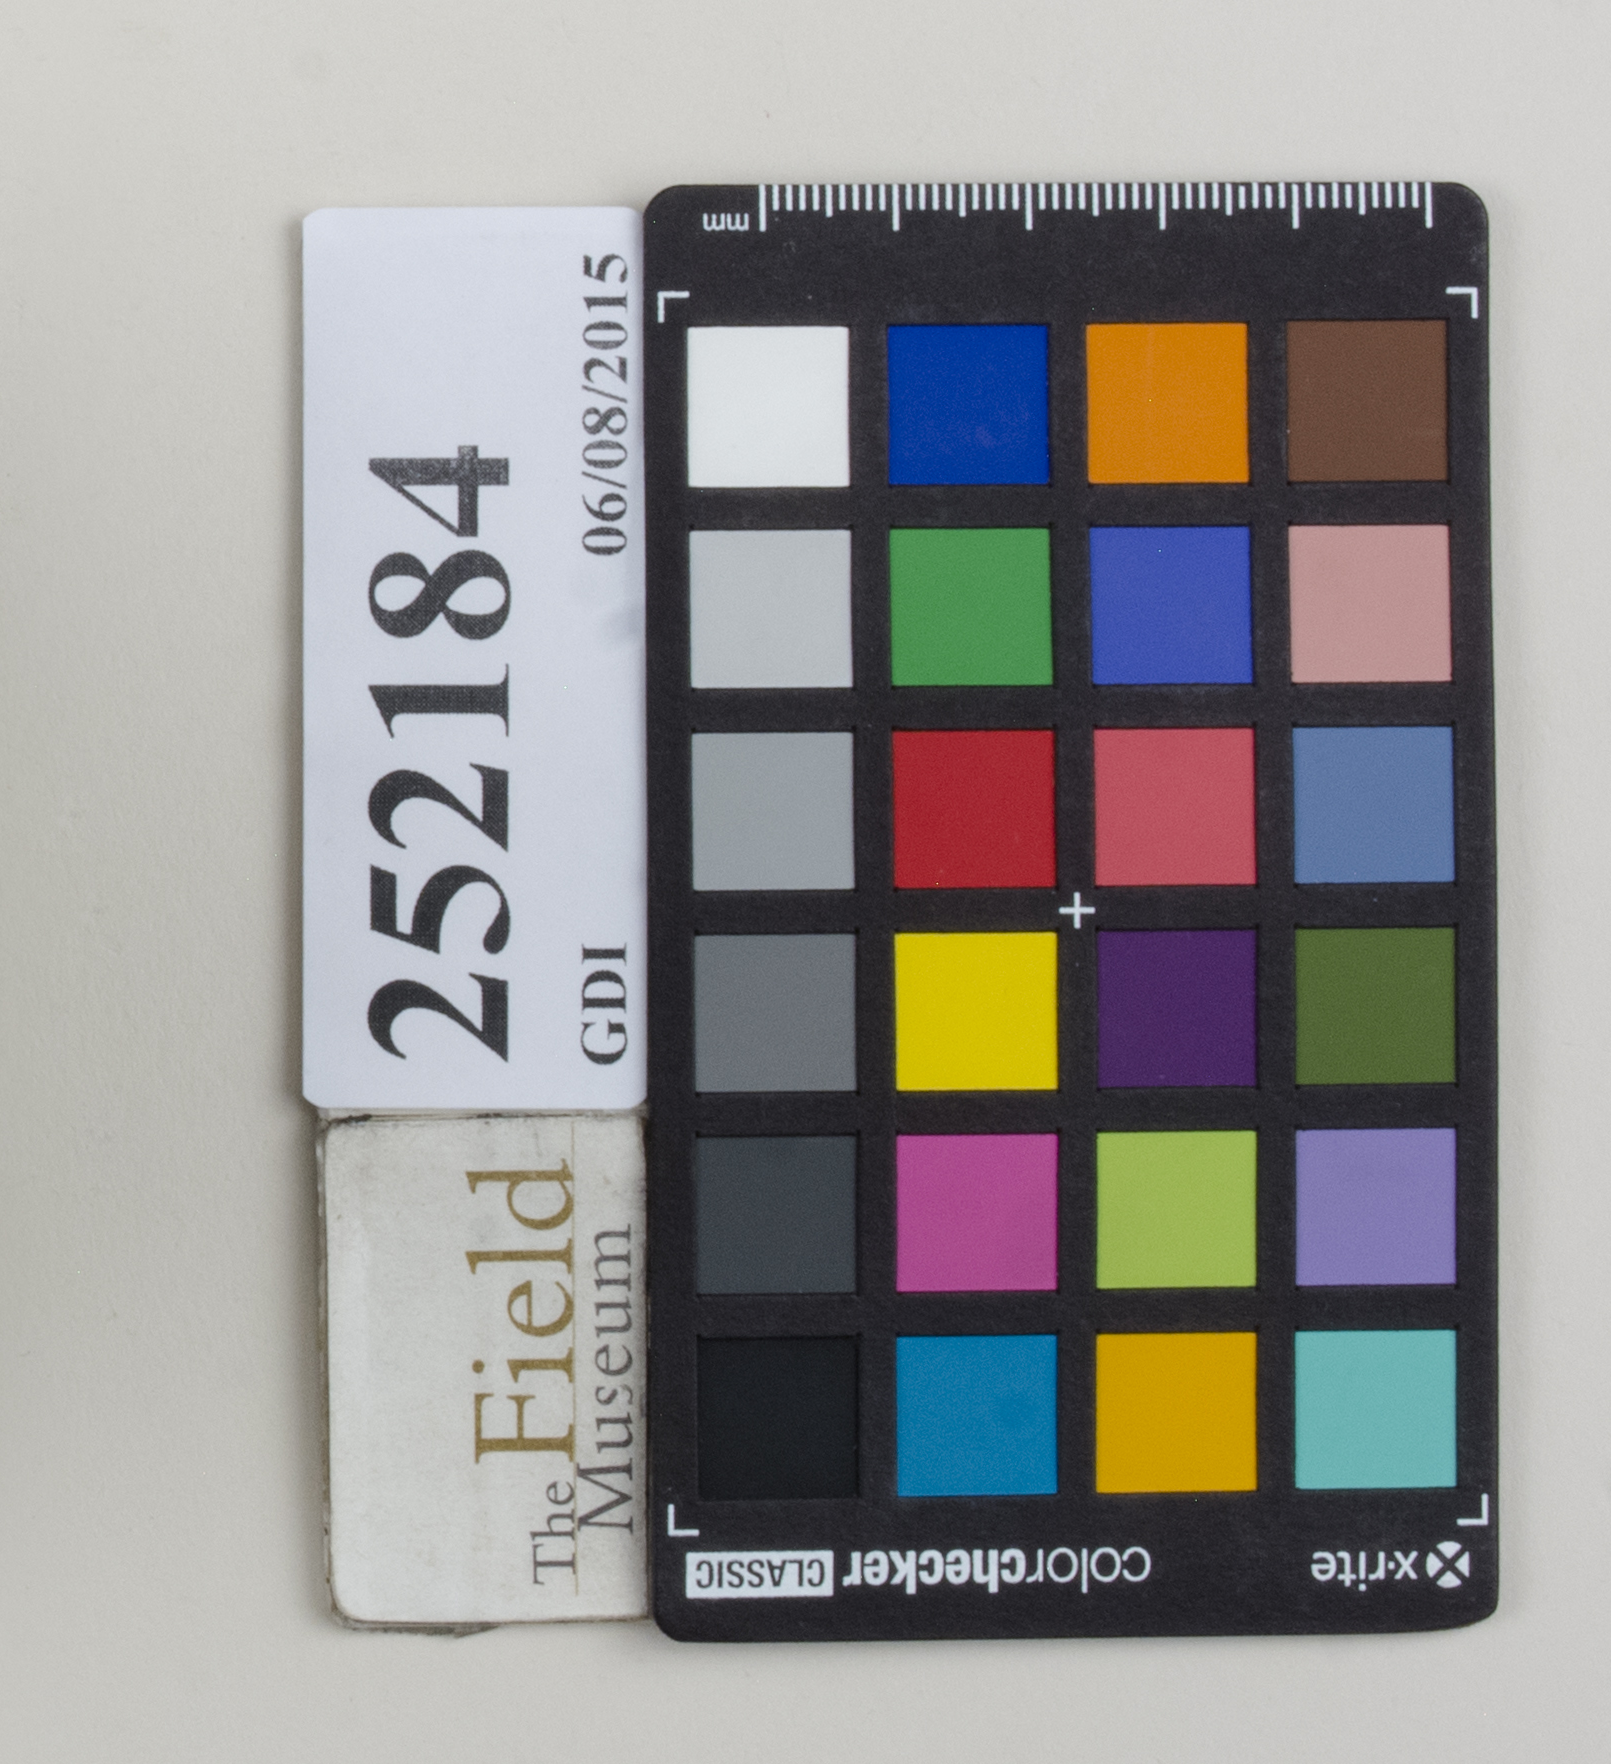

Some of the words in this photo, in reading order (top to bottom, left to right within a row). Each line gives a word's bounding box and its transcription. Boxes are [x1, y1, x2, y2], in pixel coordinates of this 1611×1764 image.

[702, 212, 750, 231] mm
[582, 253, 629, 556] 06/08/2015
[367, 445, 511, 1062] 252184
[581, 946, 628, 1066] GDI
[464, 1158, 575, 1464] Field
[577, 1223, 634, 1534] Museum
[529, 1480, 577, 1586] The
[695, 1558, 825, 1589] CLASSIC
[842, 1546, 1152, 1595] colorchecker
